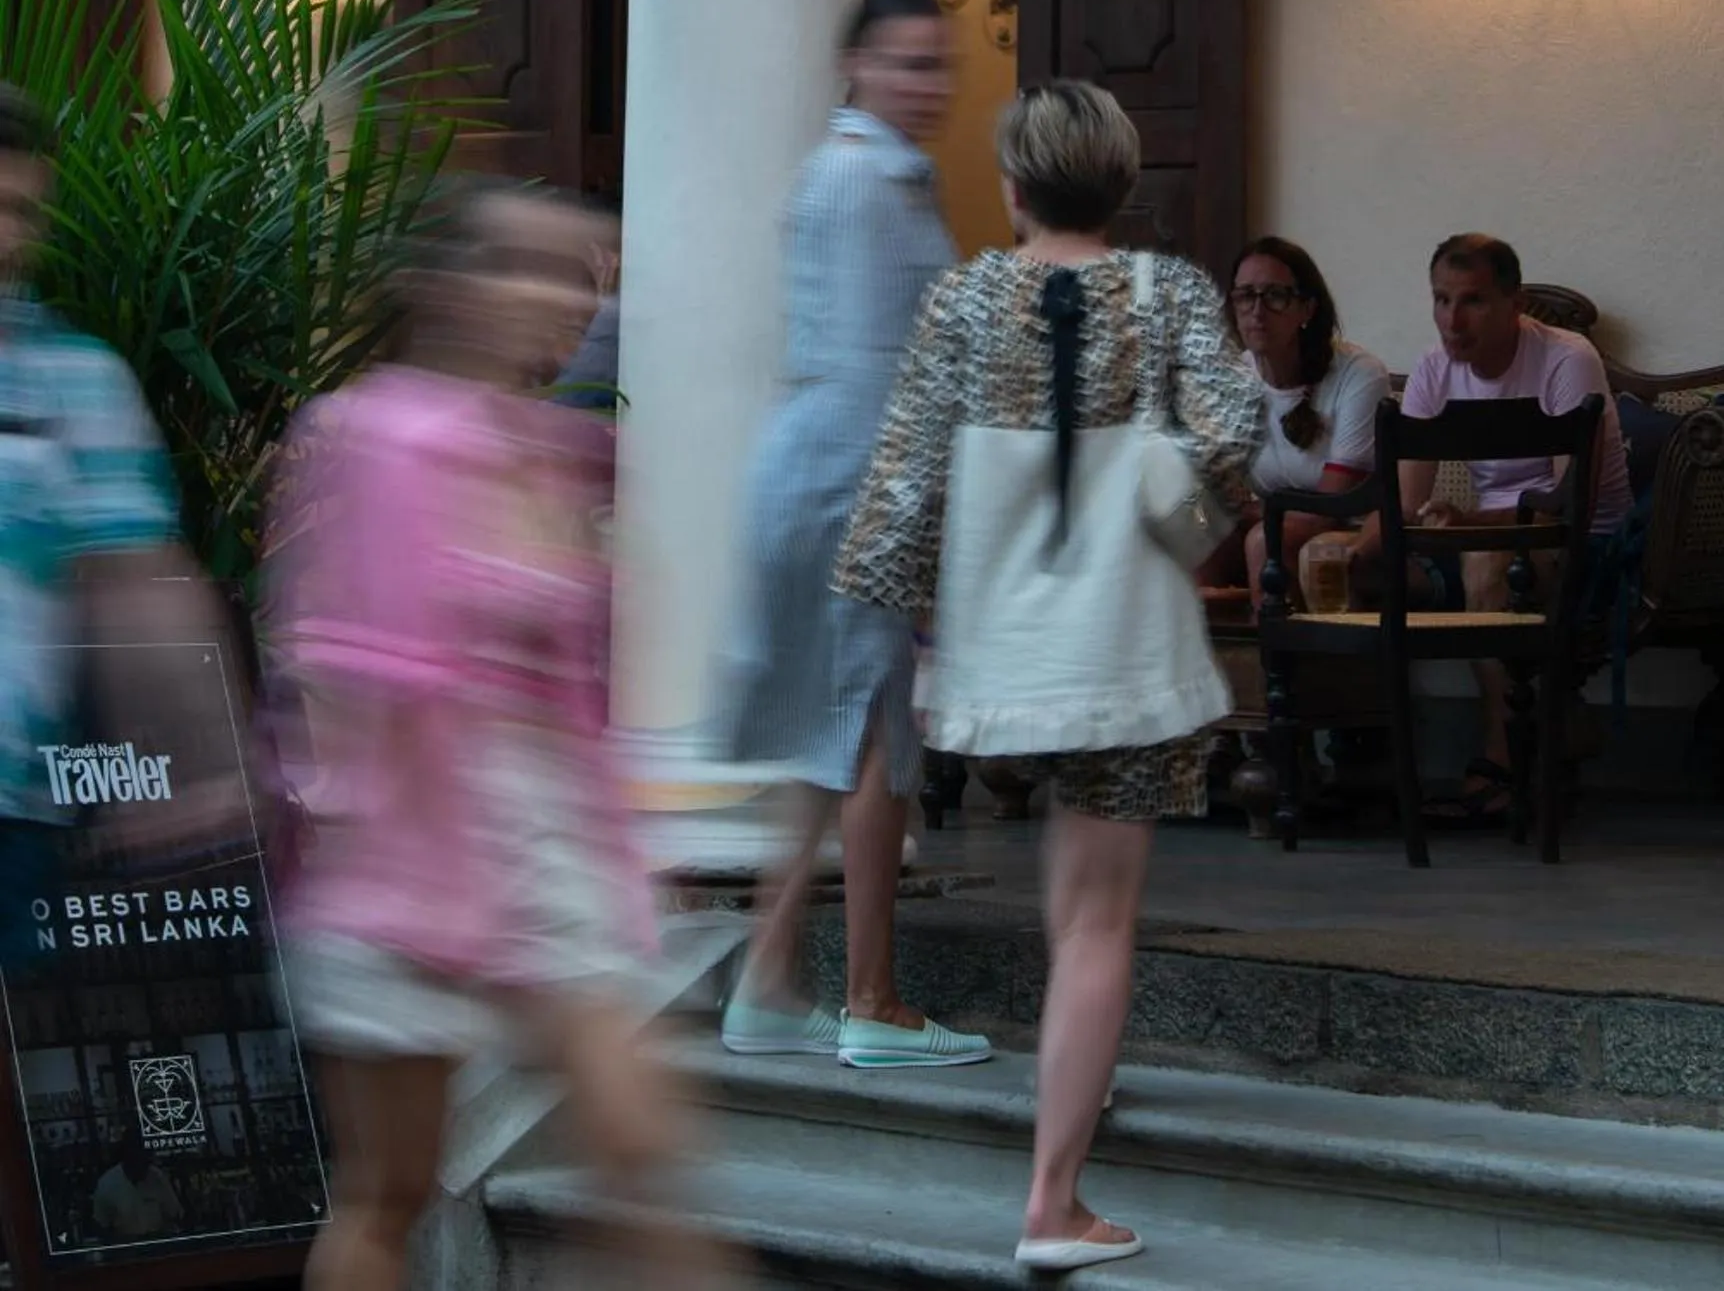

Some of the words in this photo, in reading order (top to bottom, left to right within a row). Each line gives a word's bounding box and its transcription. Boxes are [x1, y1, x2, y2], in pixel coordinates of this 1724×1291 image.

[97, 742, 126, 758] Nast
[37, 741, 172, 806] Traveler
[64, 891, 150, 919] BEST
[164, 885, 252, 913] BARS
[36, 926, 57, 951] N
[70, 921, 127, 949] SRI
[139, 914, 251, 944] LANKA
